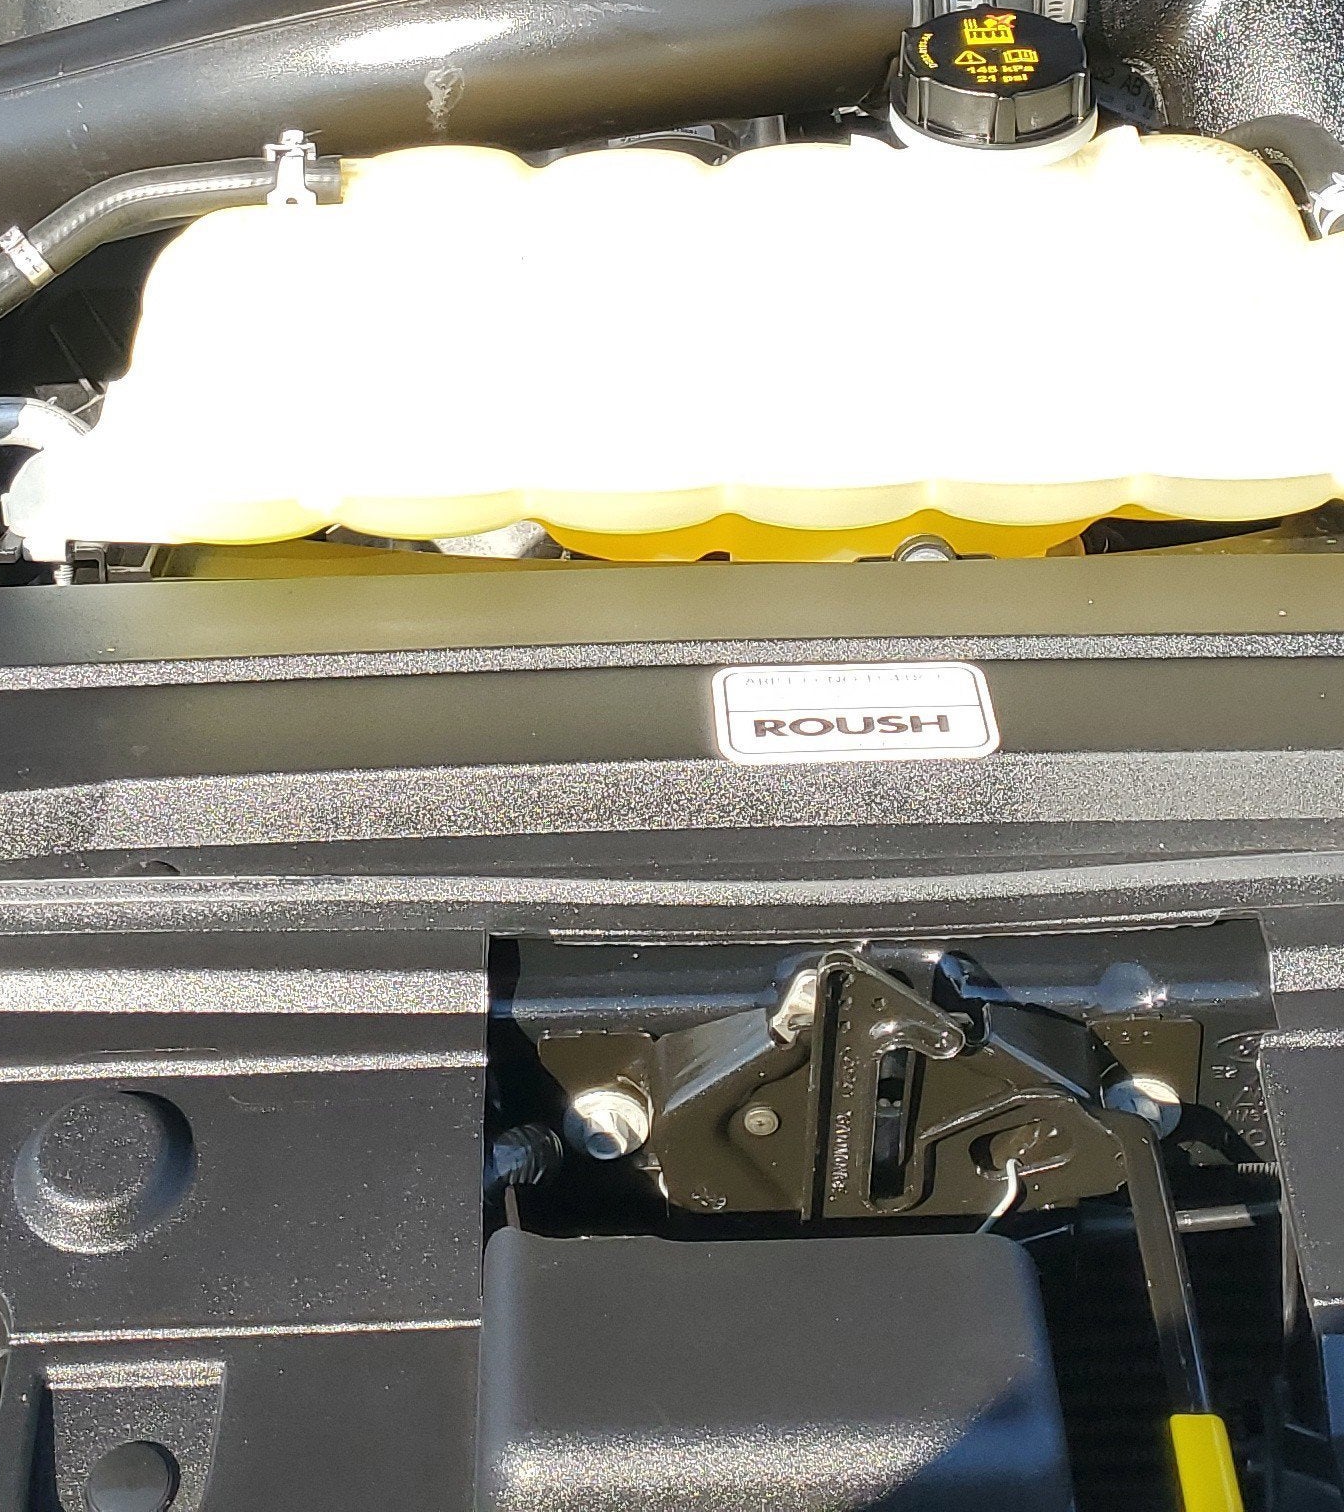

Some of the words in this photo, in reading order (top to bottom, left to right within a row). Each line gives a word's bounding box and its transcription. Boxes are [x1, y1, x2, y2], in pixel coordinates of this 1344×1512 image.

[1001, 64, 1035, 74] kPa
[1001, 73, 1029, 84] psi
[753, 714, 951, 738] ROUSH
